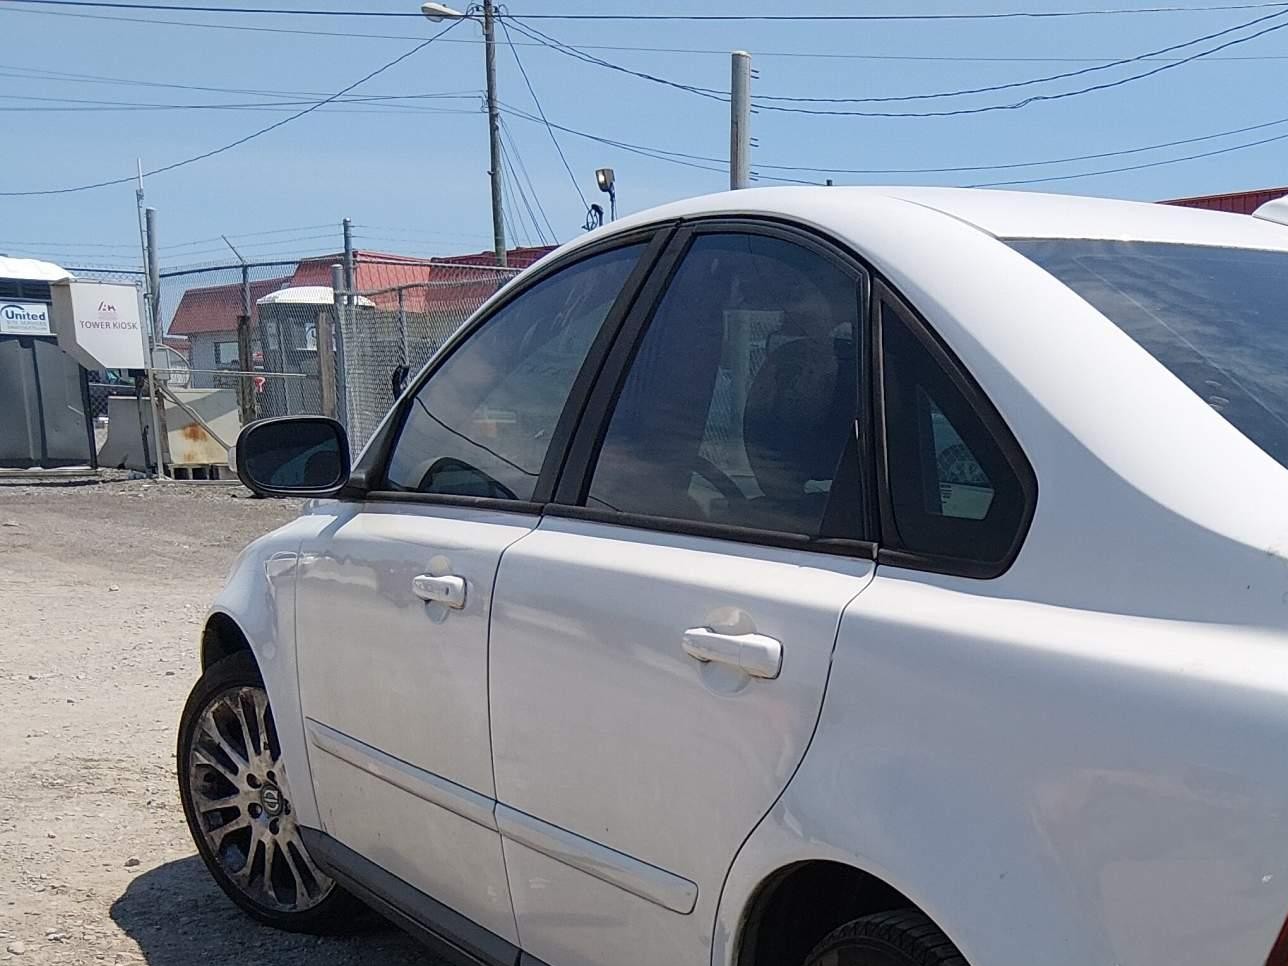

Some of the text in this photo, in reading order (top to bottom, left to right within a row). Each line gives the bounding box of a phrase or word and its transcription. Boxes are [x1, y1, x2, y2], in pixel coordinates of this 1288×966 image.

[5, 309, 46, 321] United
[80, 320, 138, 330] TOWER KIOSK
